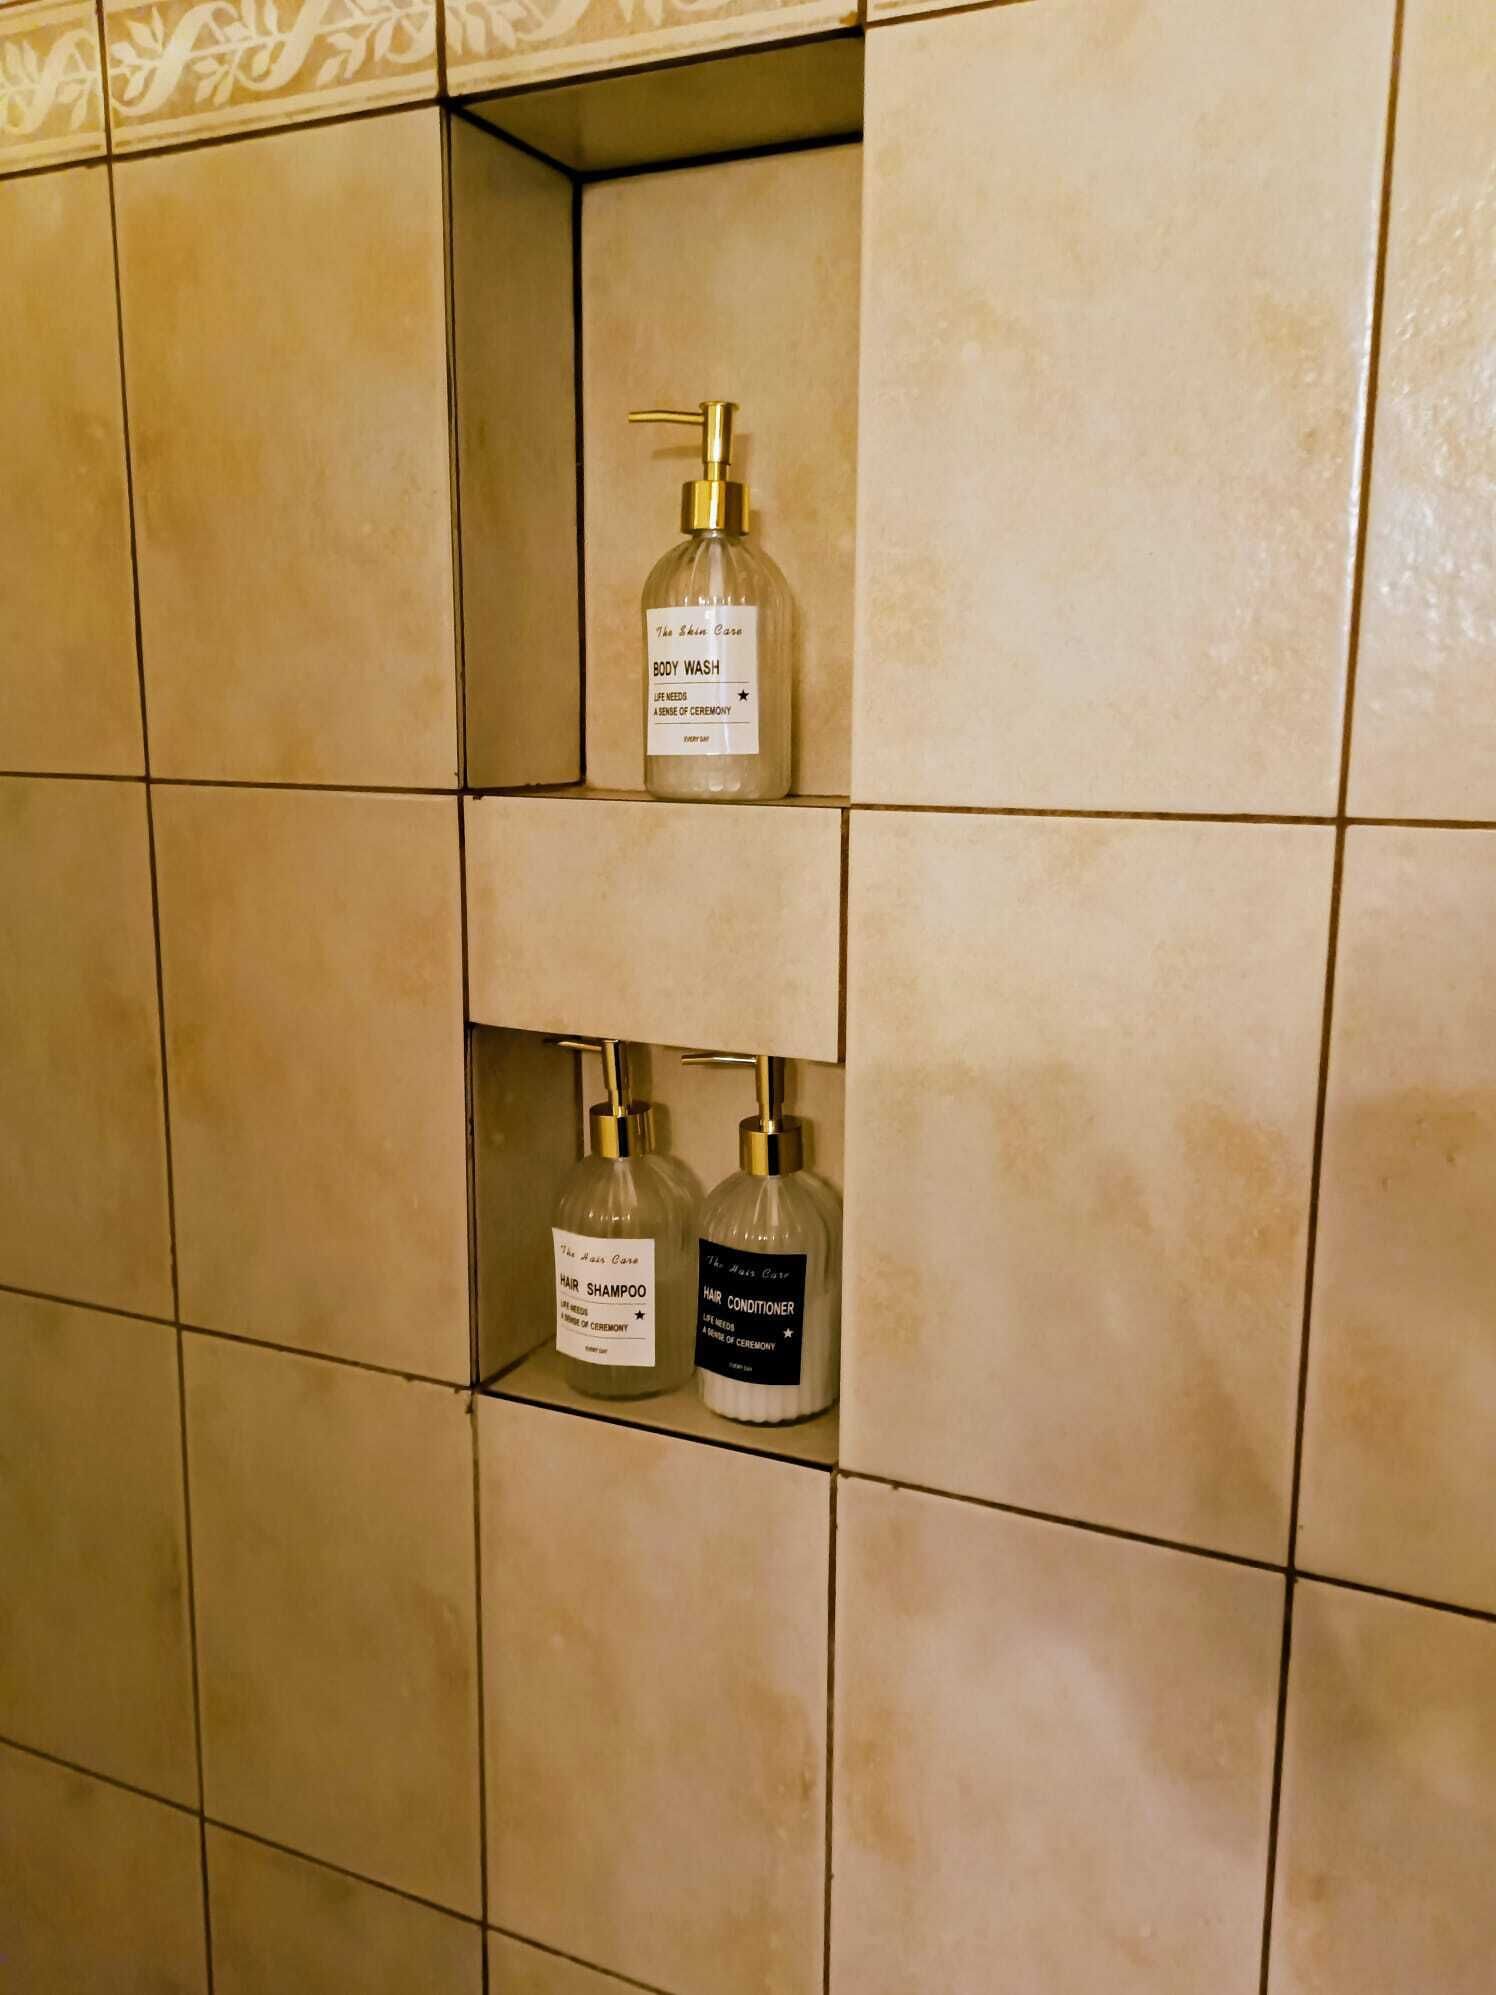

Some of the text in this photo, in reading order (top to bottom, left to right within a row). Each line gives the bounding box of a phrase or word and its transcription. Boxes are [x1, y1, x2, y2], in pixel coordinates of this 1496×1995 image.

[656, 624, 743, 638] The Skin Care
[653, 660, 720, 676] BODY WASH
[654, 692, 687, 701] LIFE NEEDS
[658, 708, 678, 716] SENSE
[679, 707, 688, 715] OF
[690, 706, 731, 715] CEREMONY
[560, 1245, 639, 1264] The Hair Care
[706, 1256, 724, 1268] The
[762, 1268, 790, 1279] Care
[560, 1274, 646, 1297] HAIR SHAMPOO
[704, 1285, 795, 1315] HAIR CONDITIONER
[581, 1320, 588, 1328] OF
[591, 1323, 628, 1332] CEREMONY
[703, 1313, 735, 1331] LIFE NEEDS
[726, 1335, 734, 1344] OF
[736, 1338, 776, 1350] CEREMONY
